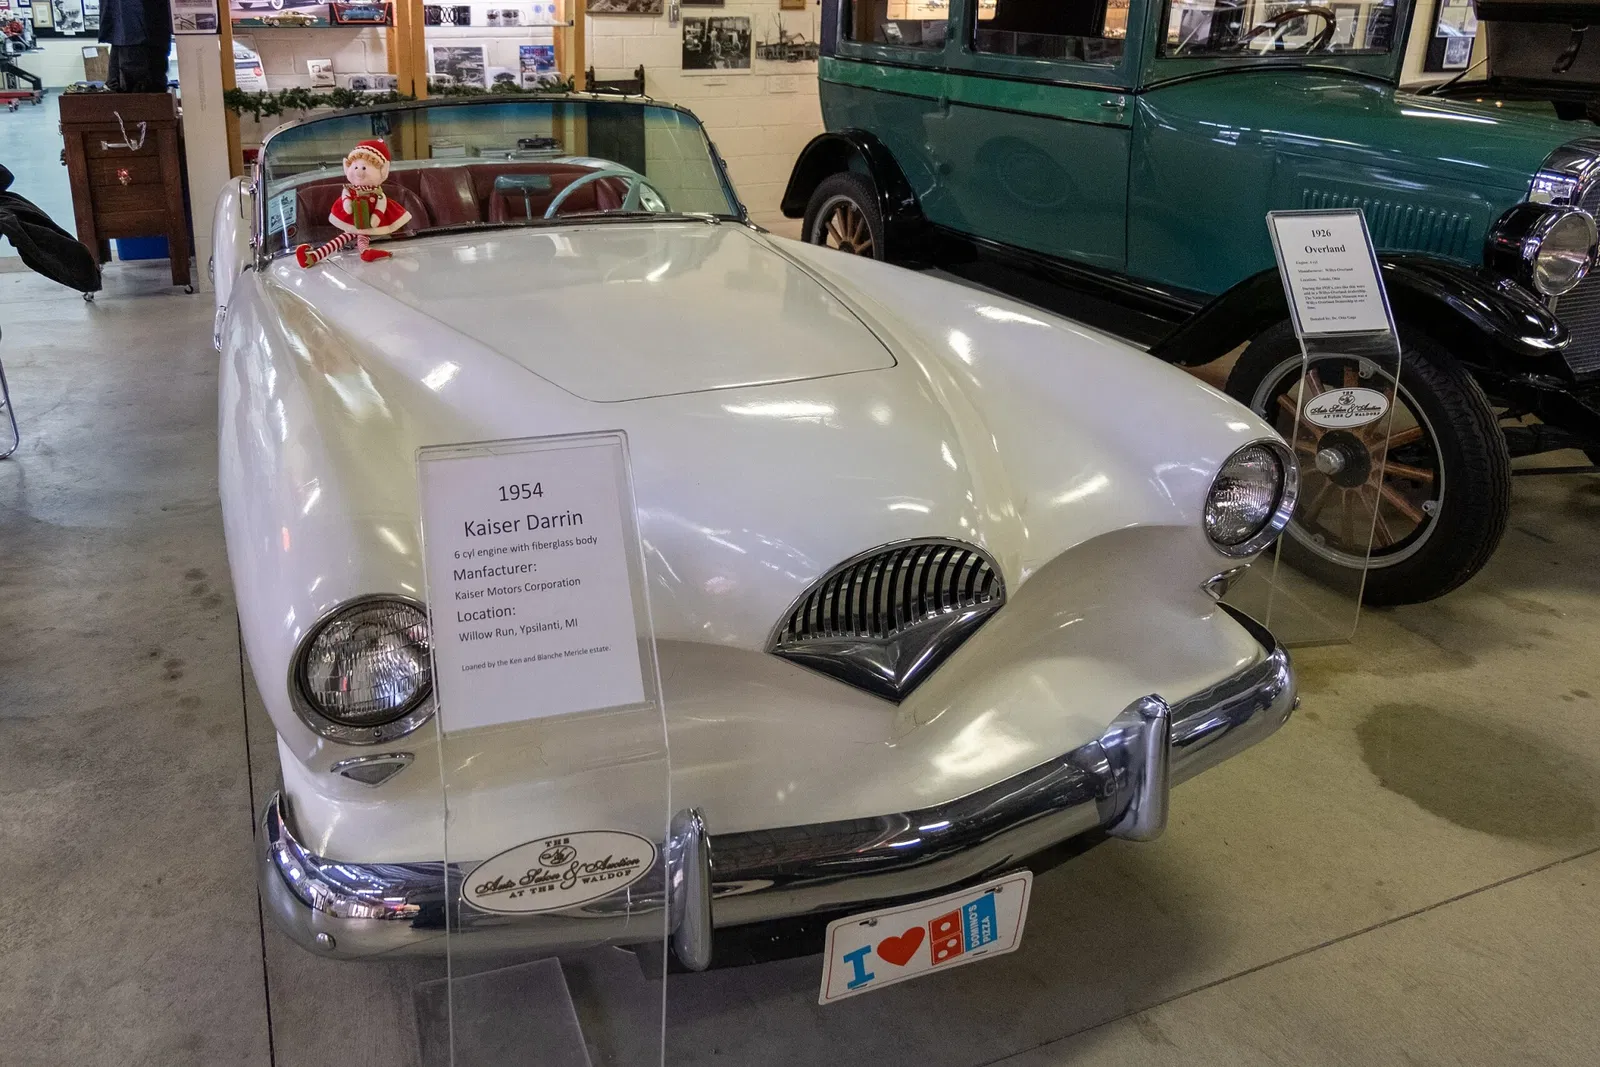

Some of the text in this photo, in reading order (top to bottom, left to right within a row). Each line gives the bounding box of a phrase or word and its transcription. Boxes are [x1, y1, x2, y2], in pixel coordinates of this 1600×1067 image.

[1311, 229, 1332, 238] 1926
[1304, 244, 1346, 254] Overland
[498, 482, 544, 502] 1954
[464, 510, 583, 537] Kaiser Darrin
[454, 535, 598, 560] 6 cyl engine with fiberglass body
[453, 563, 537, 581] Manfacturer:
[454, 577, 581, 601] Kaiser Motors Corporation
[456, 606, 516, 623] Location:
[458, 618, 578, 642] Willow Run, Ypsilanti, MI
[461, 645, 612, 672] Loaned by the Ken and Blanche Mericle estate.
[545, 837, 570, 848] THE
[475, 875, 517, 894] Auto
[519, 868, 561, 887] Salon
[560, 860, 584, 890] &
[585, 855, 640, 873] Auction
[509, 890, 524, 899] AT
[530, 885, 555, 895] THE
[968, 904, 980, 948] DOMINO'S
[981, 915, 991, 943] PIZZA
[843, 944, 875, 989] I
